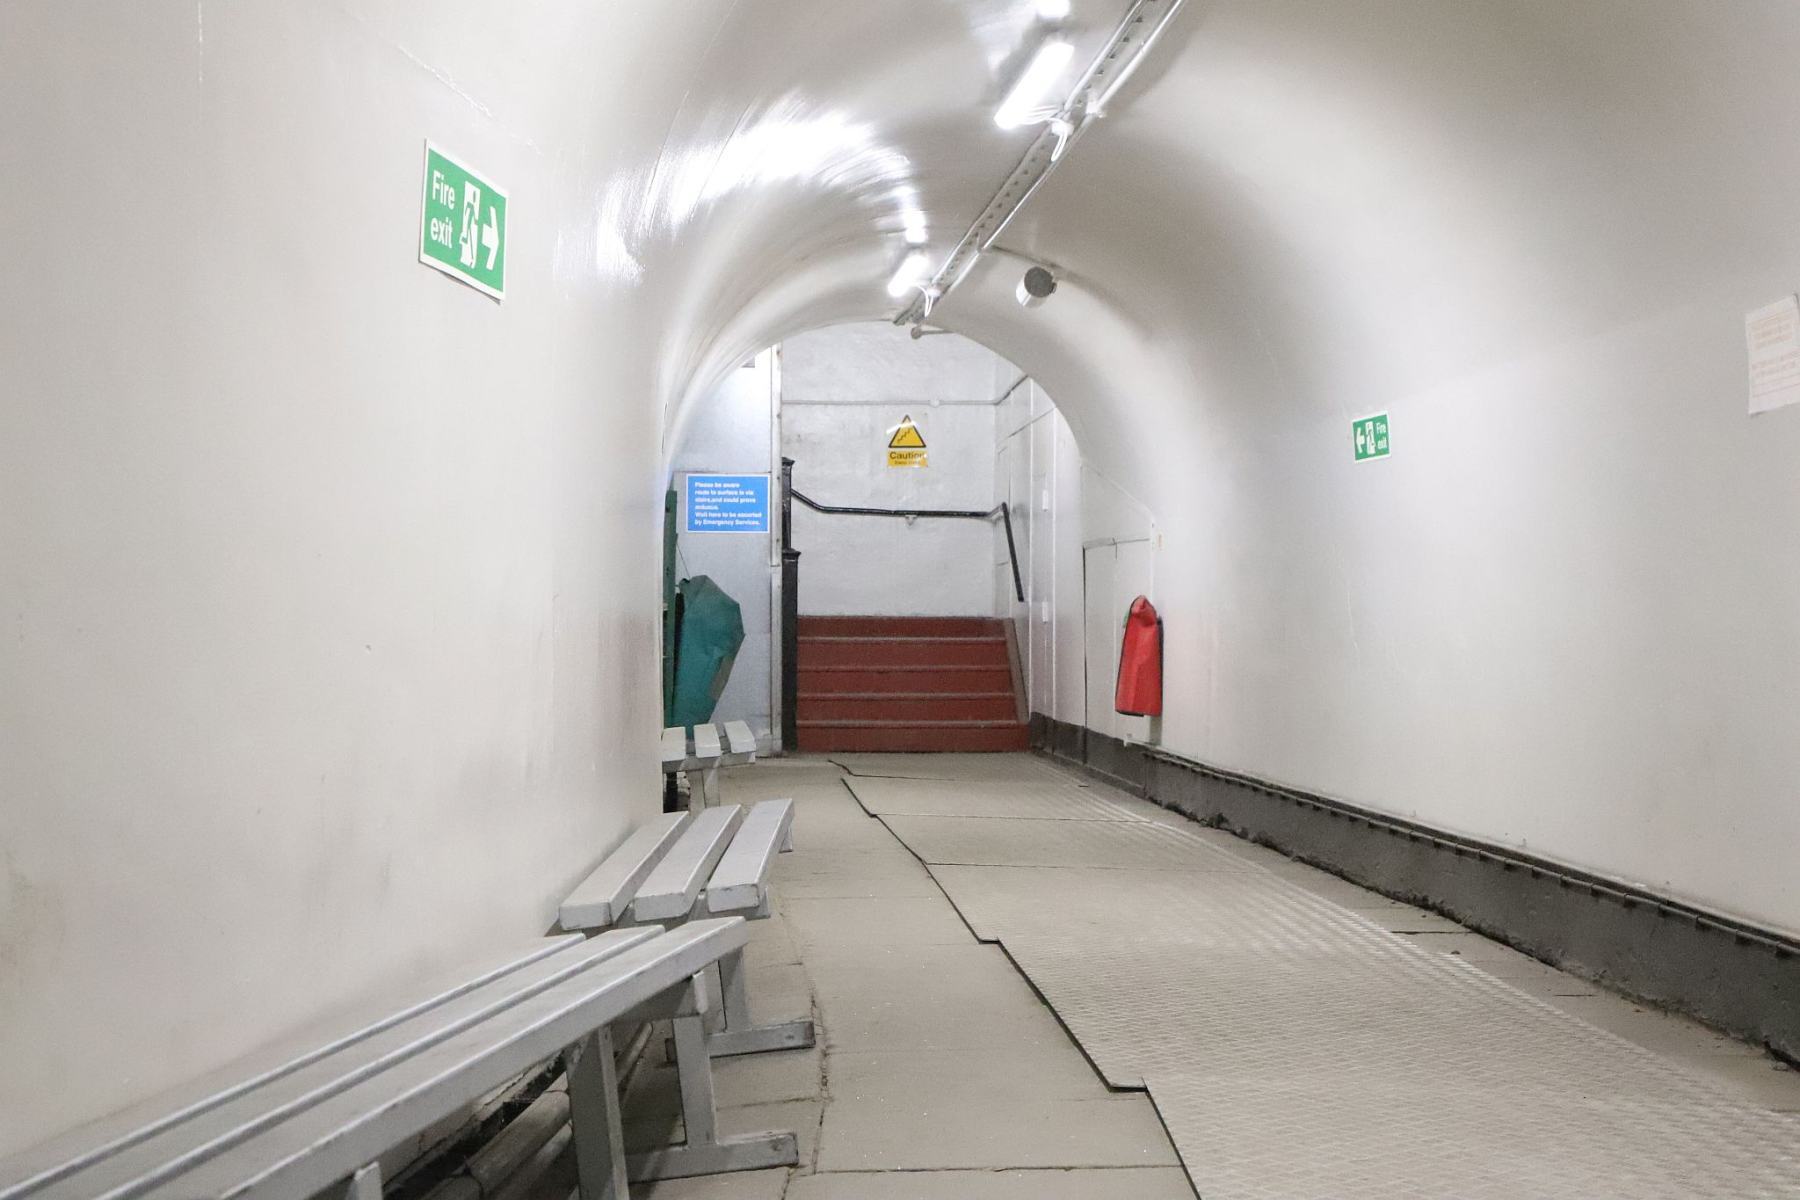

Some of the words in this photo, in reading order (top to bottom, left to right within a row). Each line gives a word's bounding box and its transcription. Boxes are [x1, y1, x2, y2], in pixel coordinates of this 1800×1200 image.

[432, 170, 455, 210] Fire
[430, 217, 453, 249] exit
[1376, 422, 1386, 434] Fire
[1378, 437, 1387, 449] exit
